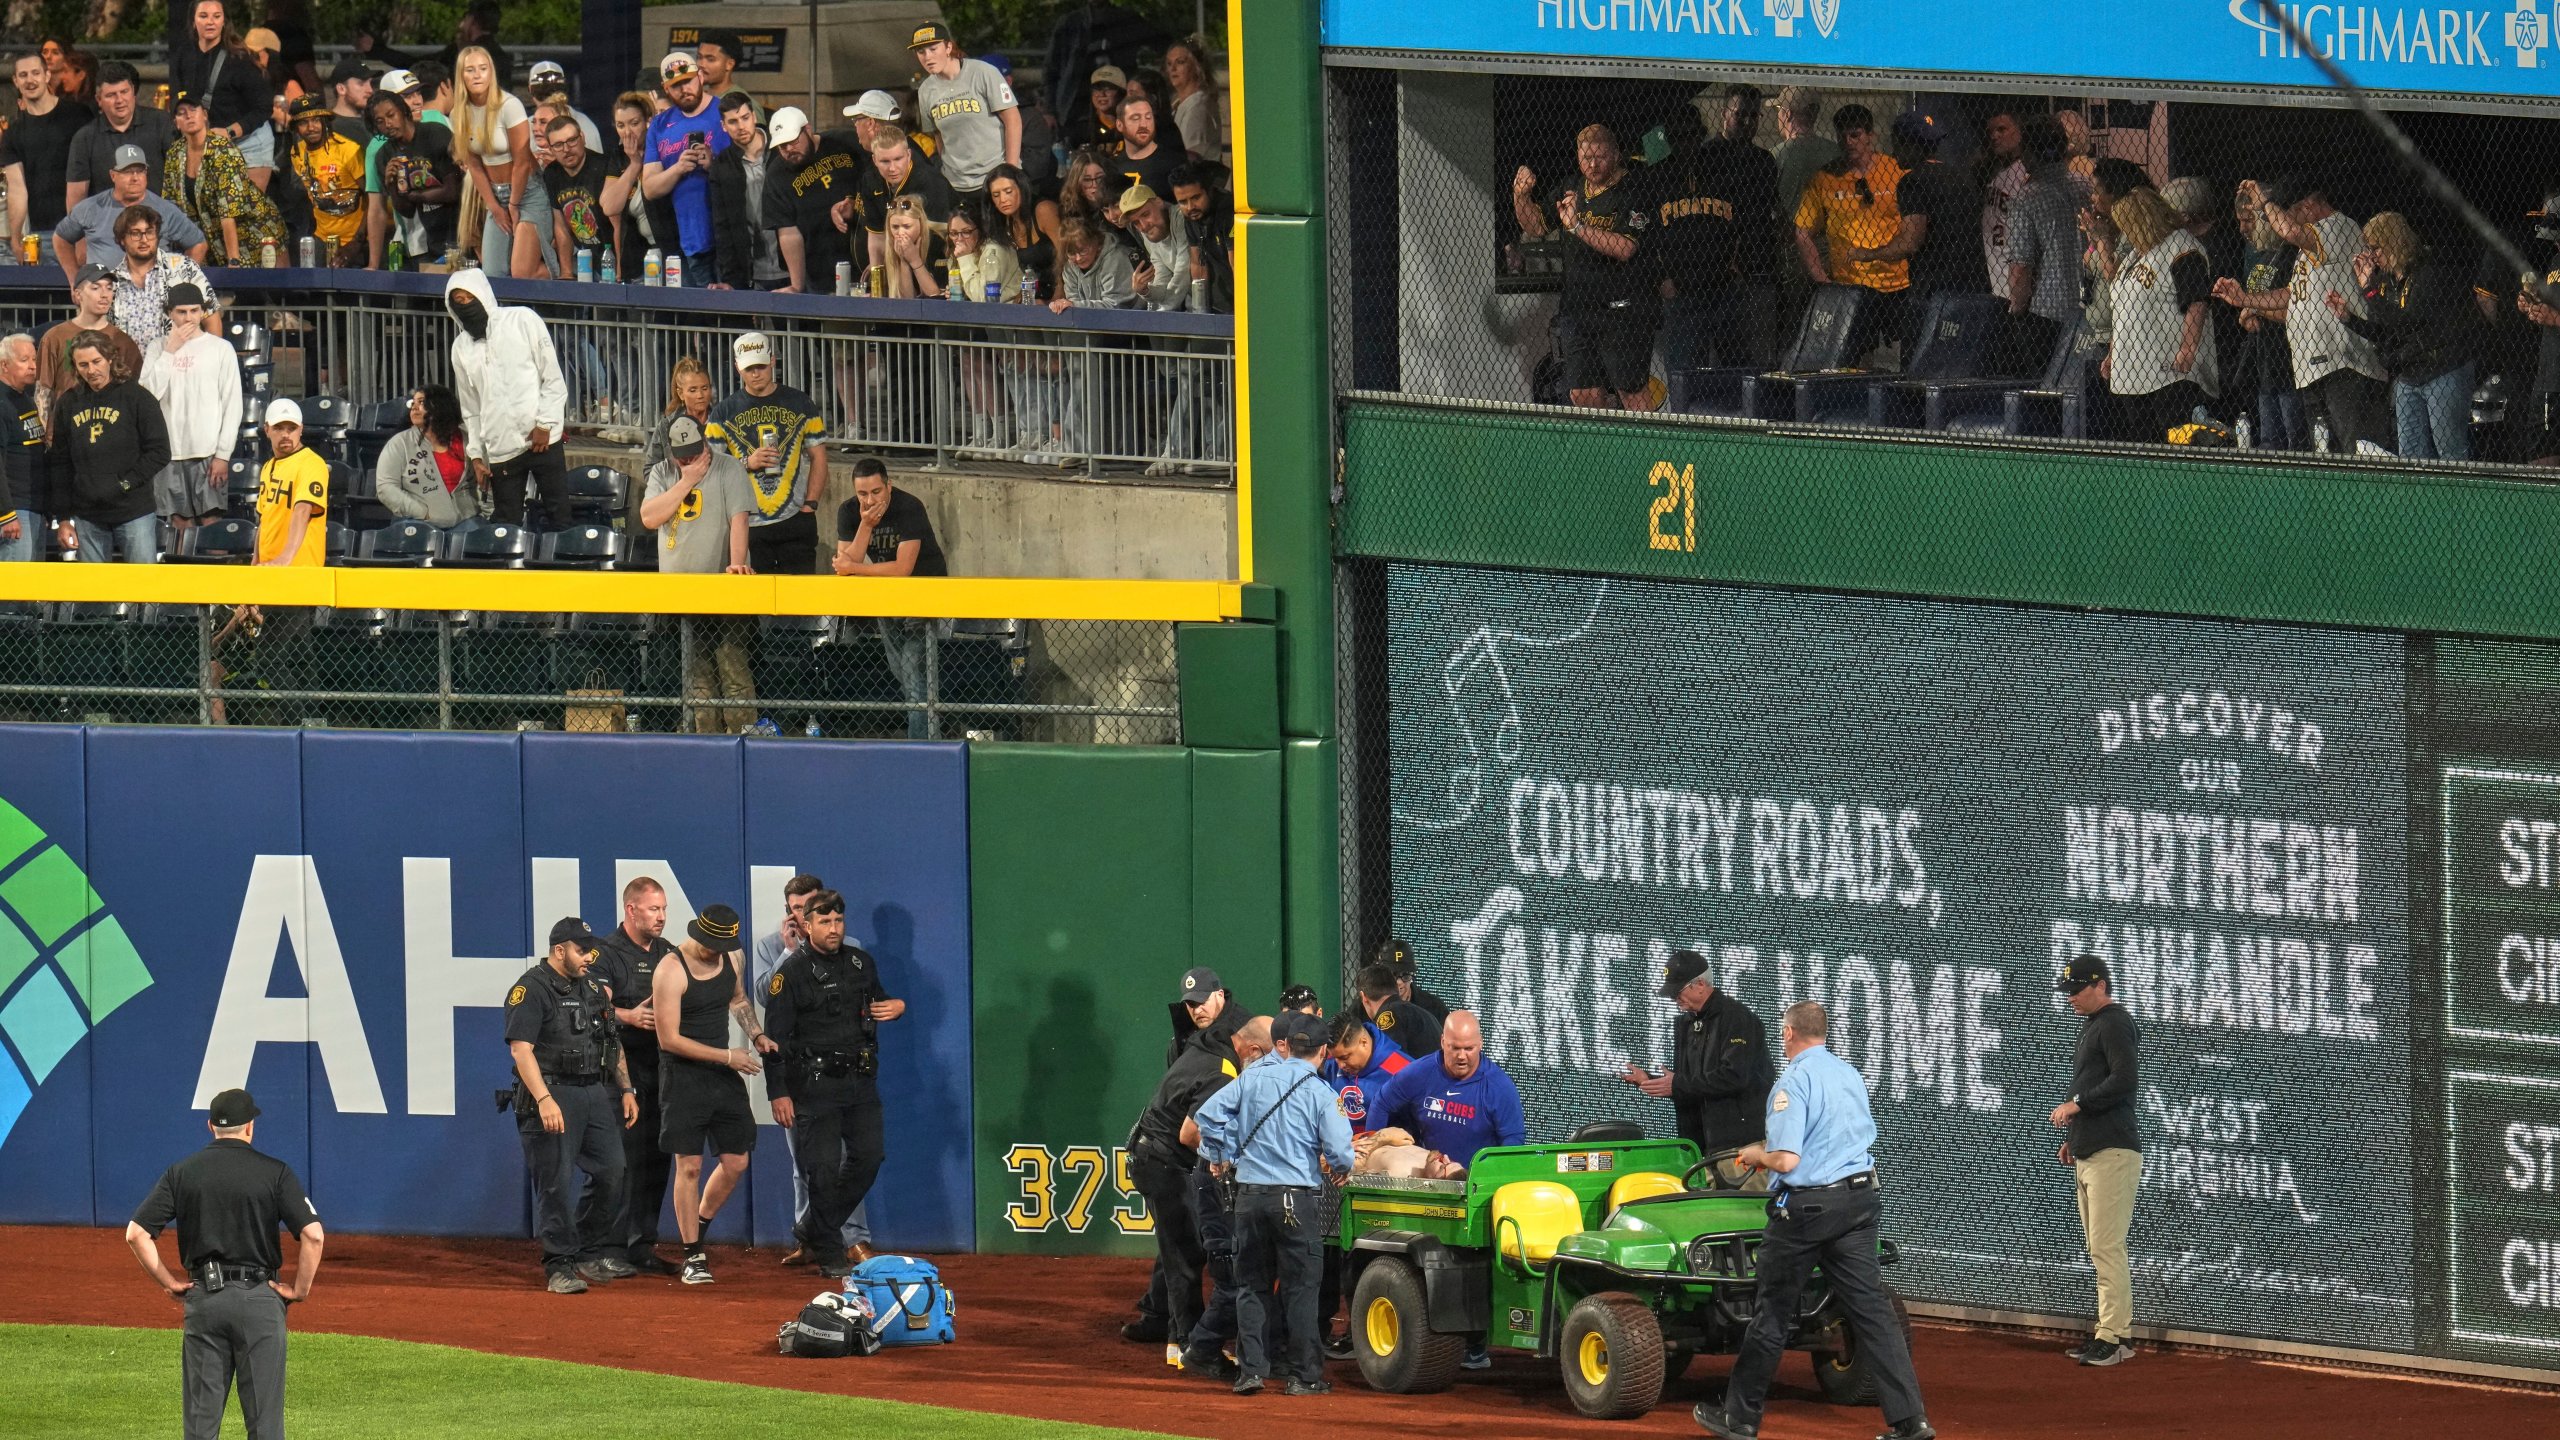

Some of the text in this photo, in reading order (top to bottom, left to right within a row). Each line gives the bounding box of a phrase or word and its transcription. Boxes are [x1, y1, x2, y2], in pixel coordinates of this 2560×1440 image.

[1537, 0, 1752, 36] HIGHMARK
[2259, 2, 2492, 66] HIGHMARK
[671, 29, 699, 44] 1974
[931, 99, 981, 119] PIRATES
[127, 147, 138, 157] R
[792, 153, 854, 197] PIRATES
[821, 174, 832, 189] P
[1660, 198, 1733, 227] PIRATES
[738, 341, 765, 353] Pittsburgh
[73, 406, 120, 428] PIRATES
[735, 406, 797, 429] PIRATES
[680, 432, 689, 443] P
[1648, 461, 1695, 552] 21
[2099, 692, 2325, 772] DISCOVER
[2179, 758, 2241, 794] OUR
[1508, 777, 1944, 928] COUNTRY ROADS,
[2065, 804, 2359, 923] NORTHERN
[2500, 819, 2560, 887] ST
[1395, 951, 1403, 963] P
[192, 854, 796, 1126] AHN
[2051, 920, 2378, 1041] PANHANDLE
[1452, 885, 1630, 1077] TAKE
[1777, 948, 2003, 1113] HOME
[1427, 1111, 1466, 1125] BASEBALL
[1446, 1101, 1476, 1119] CUBS
[2146, 1086, 2266, 1144] WEST
[1002, 1144, 1156, 1236] 375
[2140, 1145, 2320, 1222] VIRGINIA
[1423, 1206, 1458, 1218] JOHN DEERE
[812, 1328, 831, 1339] Series
